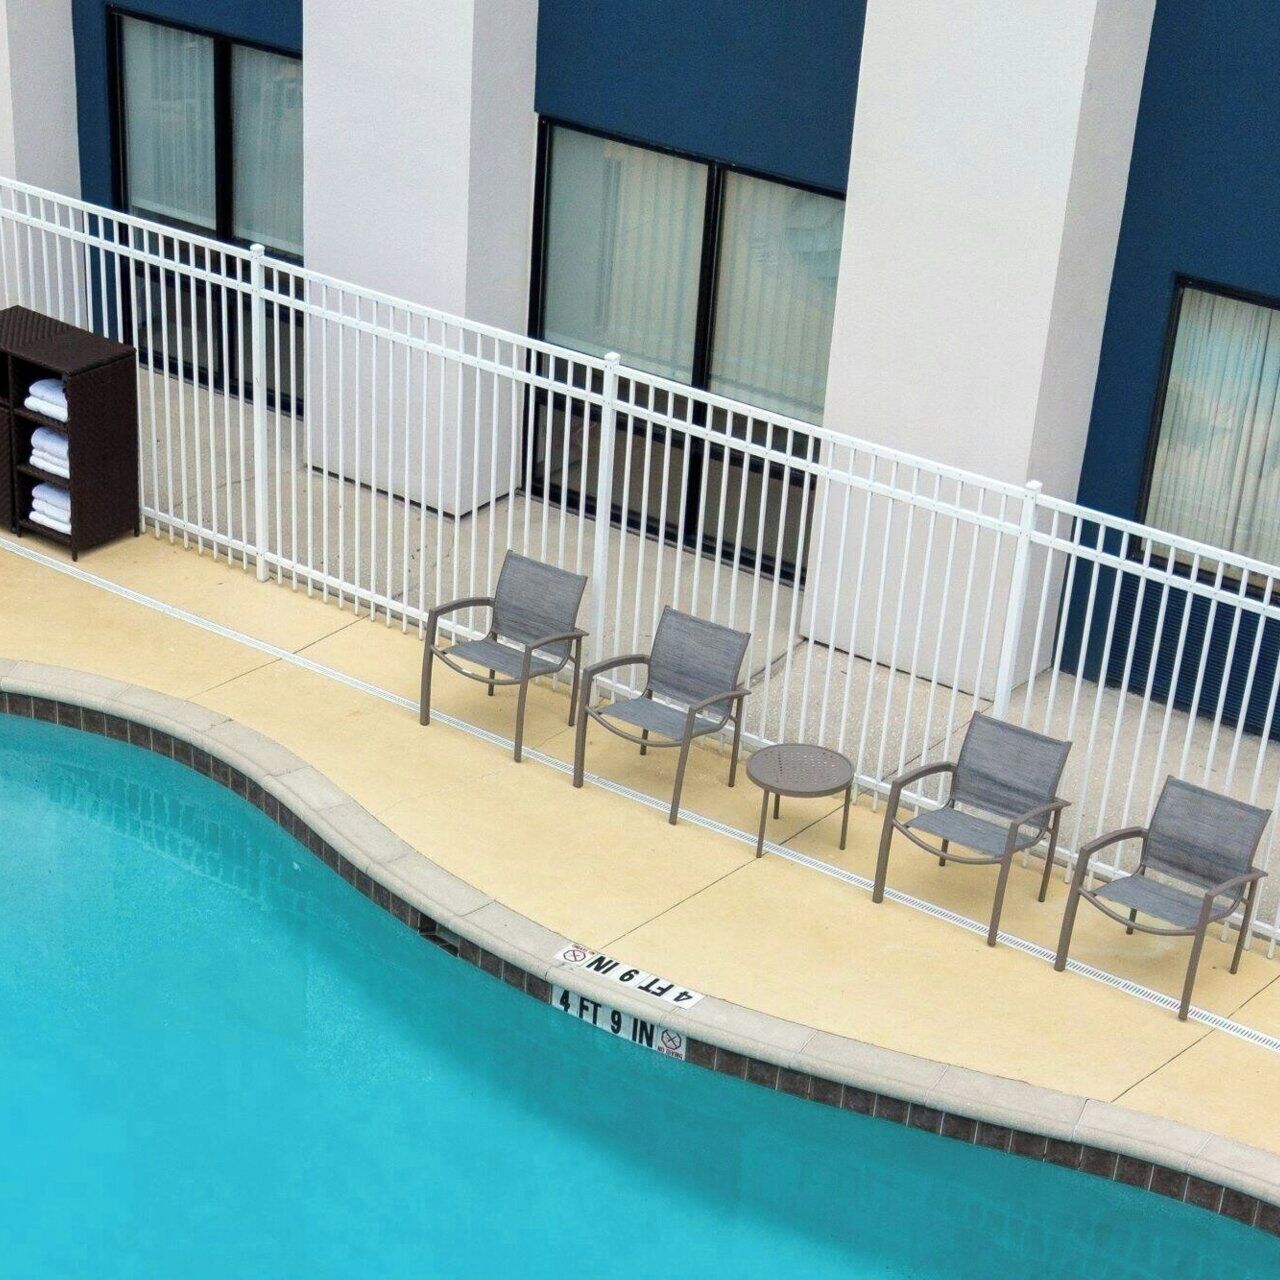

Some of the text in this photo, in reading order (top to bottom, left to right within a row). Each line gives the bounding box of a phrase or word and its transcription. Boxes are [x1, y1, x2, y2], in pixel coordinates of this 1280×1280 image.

[586, 955, 693, 1003] 4 FT 9 IN
[560, 989, 654, 1047] 4 FT 9 IN
